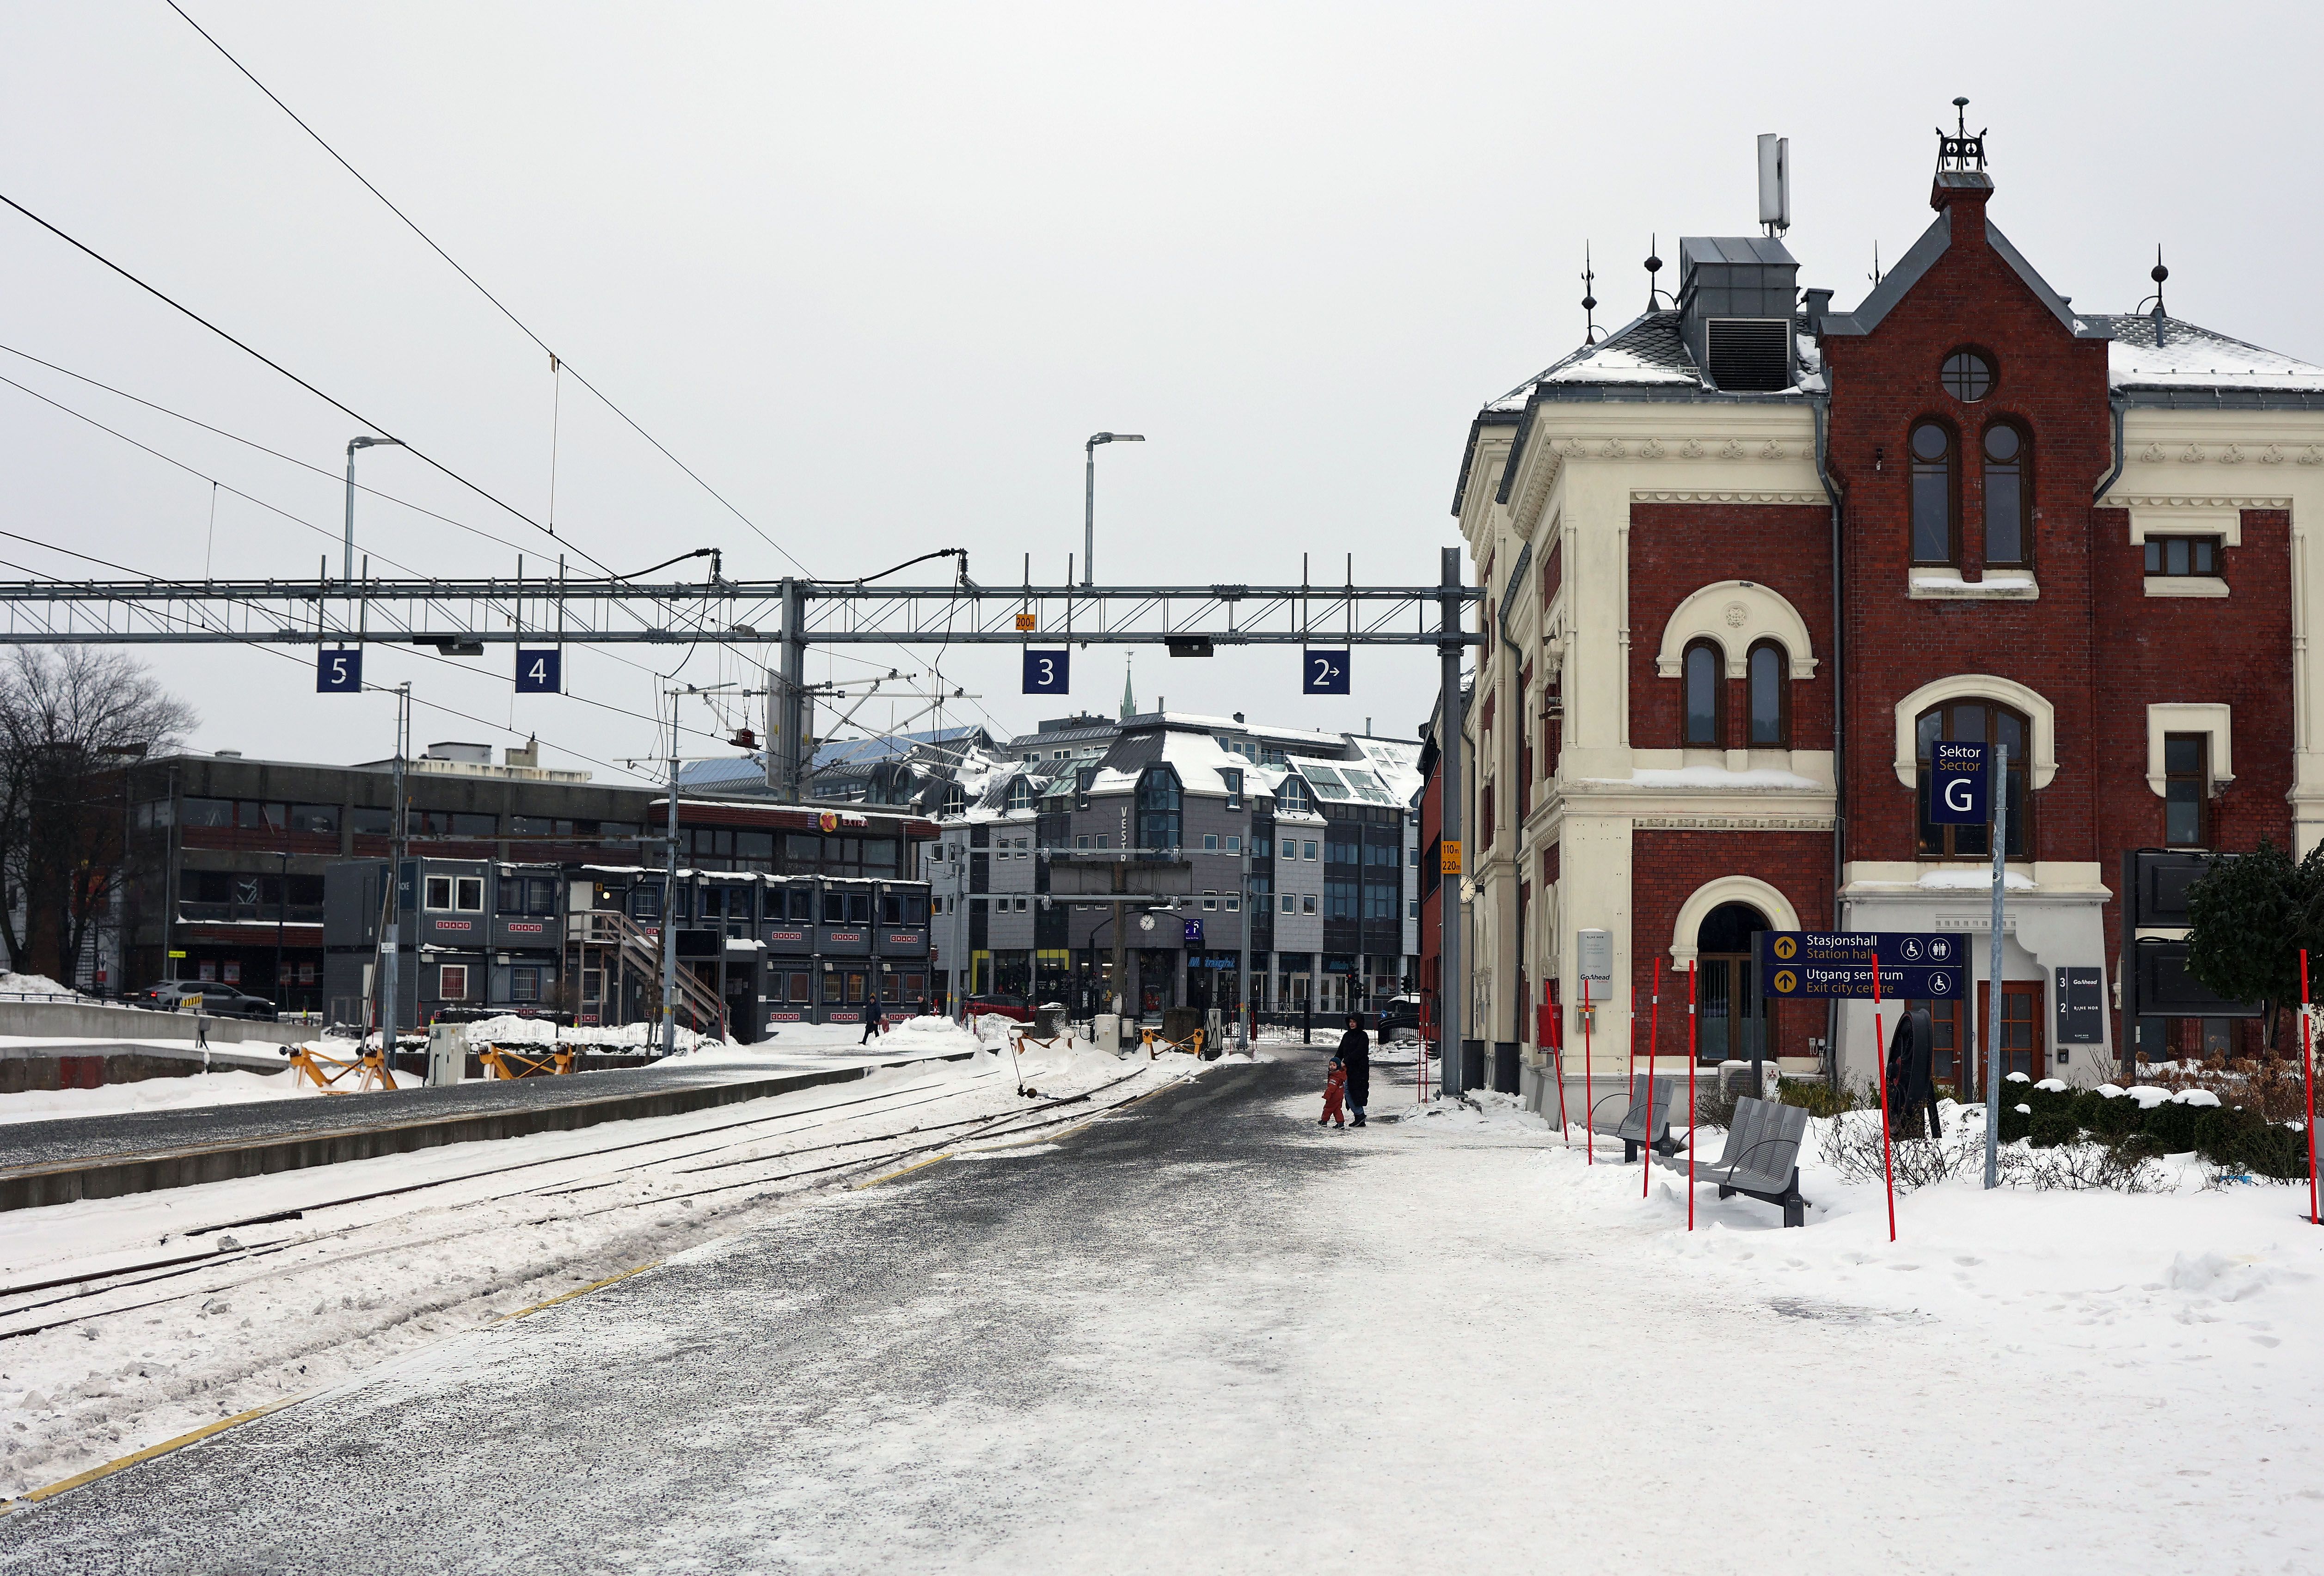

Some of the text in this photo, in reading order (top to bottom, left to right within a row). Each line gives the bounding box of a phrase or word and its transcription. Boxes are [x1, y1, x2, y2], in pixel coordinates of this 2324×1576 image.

[331, 658, 347, 684] 5
[528, 658, 546, 684] 4
[1037, 658, 1054, 685] 3
[1313, 659, 1330, 685] 2
[1939, 745, 1981, 758] Sektor
[1939, 759, 1981, 771] Sector
[1945, 779, 1972, 811] G
[842, 818, 869, 827] EXTRA
[1807, 935, 1877, 948] Stasjonshall
[1807, 948, 1849, 959] Station
[1807, 969, 1903, 982] Utgang senrum
[2060, 977, 2066, 987] 3
[1807, 982, 1828, 993] Exit
[1832, 982, 1853, 995] city
[2060, 1003, 2066, 1013] 2
